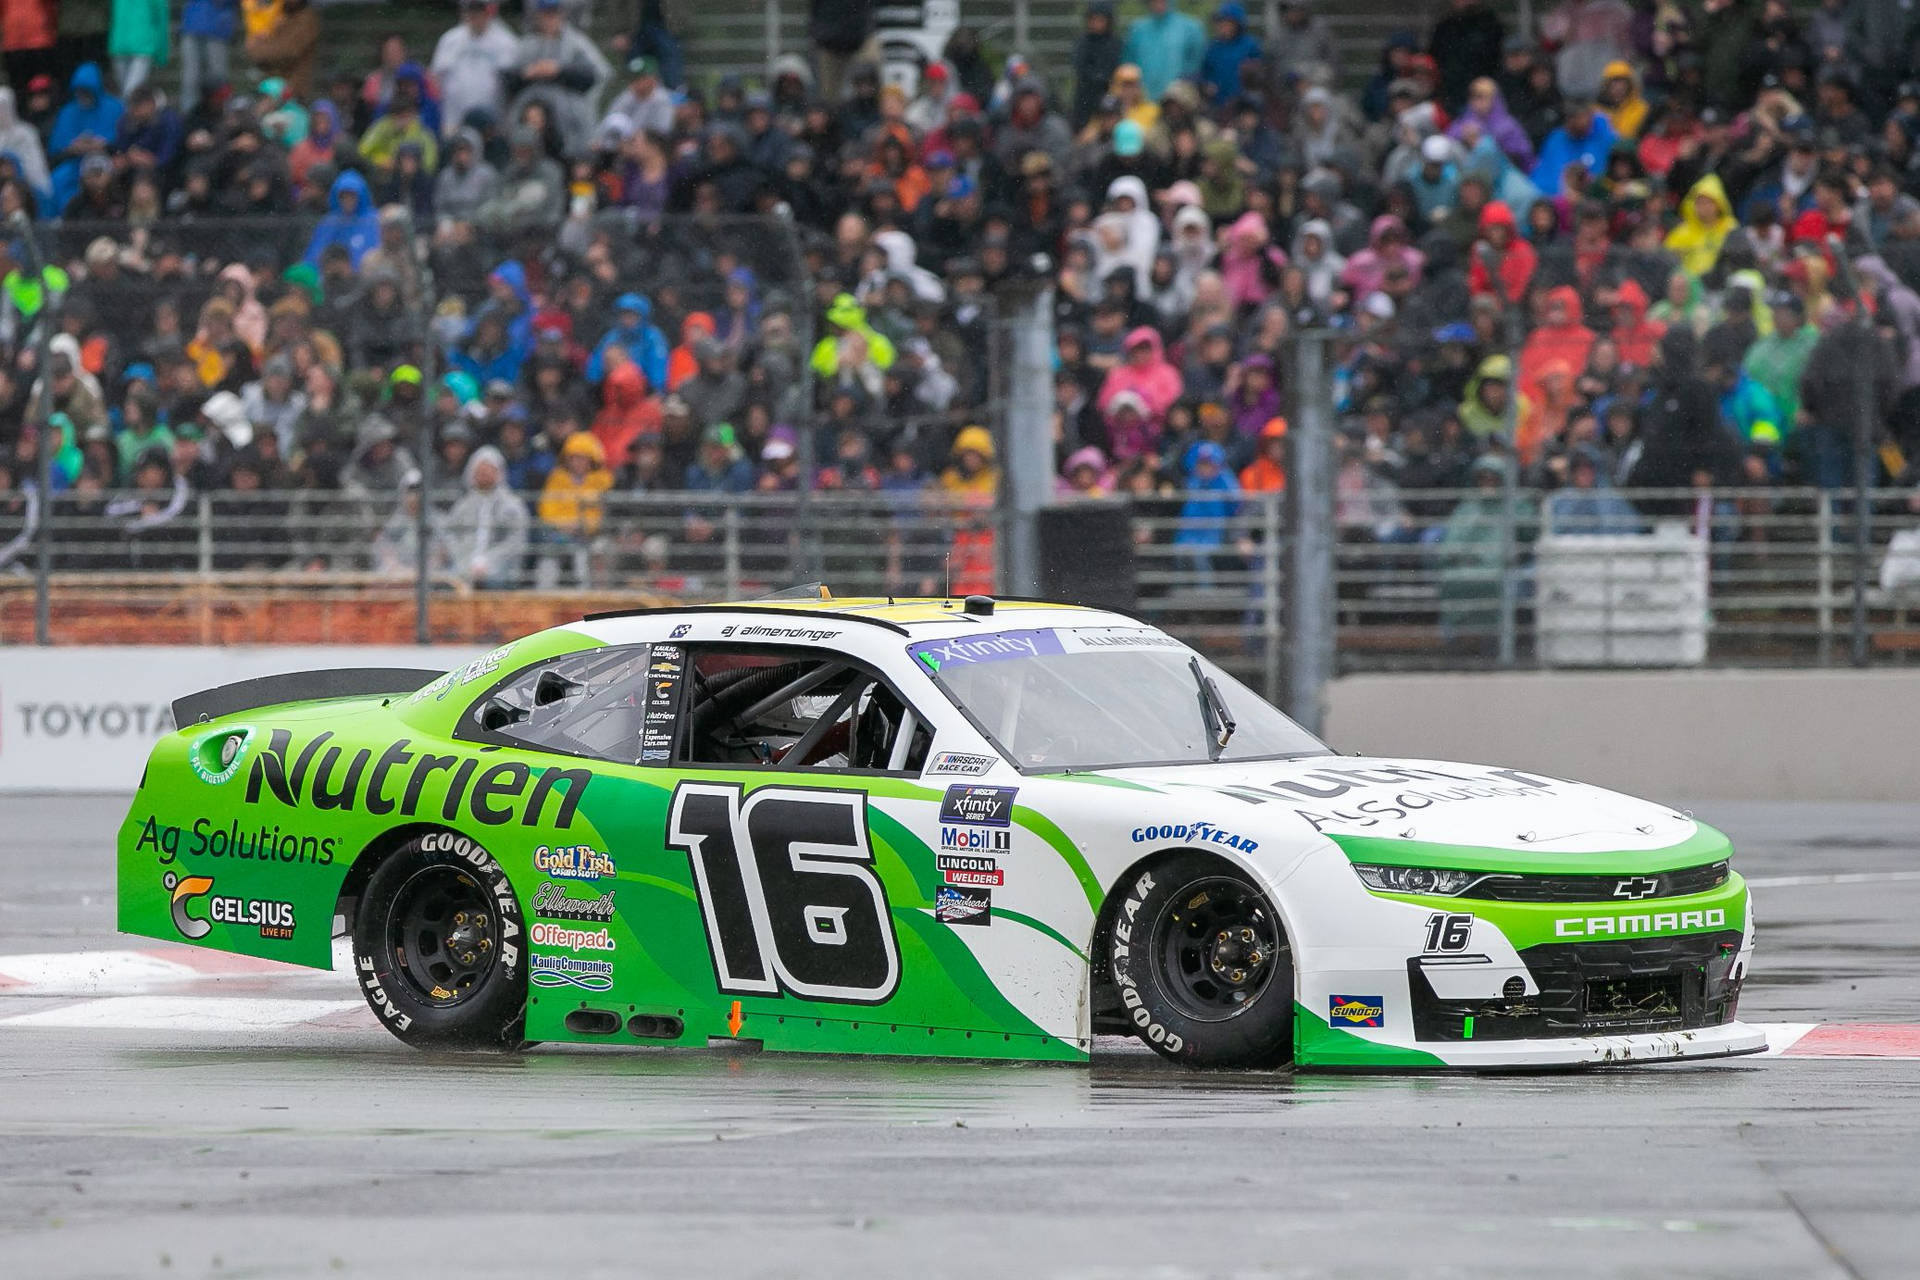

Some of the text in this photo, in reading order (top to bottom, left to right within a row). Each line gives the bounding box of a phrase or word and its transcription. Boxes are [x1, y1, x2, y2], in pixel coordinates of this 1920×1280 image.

[740, 625, 843, 641] allmendinger
[934, 636, 1038, 663] xfinity
[646, 711, 675, 720] Nutrien
[644, 734, 672, 742] Expensive
[952, 755, 987, 765] NASCAR
[961, 765, 980, 773] CAR
[245, 728, 593, 830] Nutrien
[953, 795, 1002, 817] xfinity
[965, 812, 986, 821] SERIES
[136, 815, 335, 866] Ag Solutions
[941, 827, 990, 849] Mobil
[535, 844, 616, 877] Gold Fish
[939, 857, 993, 871] LINCOLN
[551, 868, 599, 879] CASINO SLOTS
[952, 872, 999, 884] WELDERS
[532, 881, 617, 916] Ellsworth
[665, 779, 902, 1007] 16
[211, 897, 295, 927] CELSIUS
[536, 911, 612, 923] ADVISORS
[1554, 908, 1726, 938] CAMARO
[261, 927, 293, 938] LIVE FIT
[531, 924, 607, 950] Offerpad
[1423, 912, 1475, 954] 16
[358, 955, 413, 1032] EAGLE
[1332, 1006, 1382, 1018] SUNOCO
